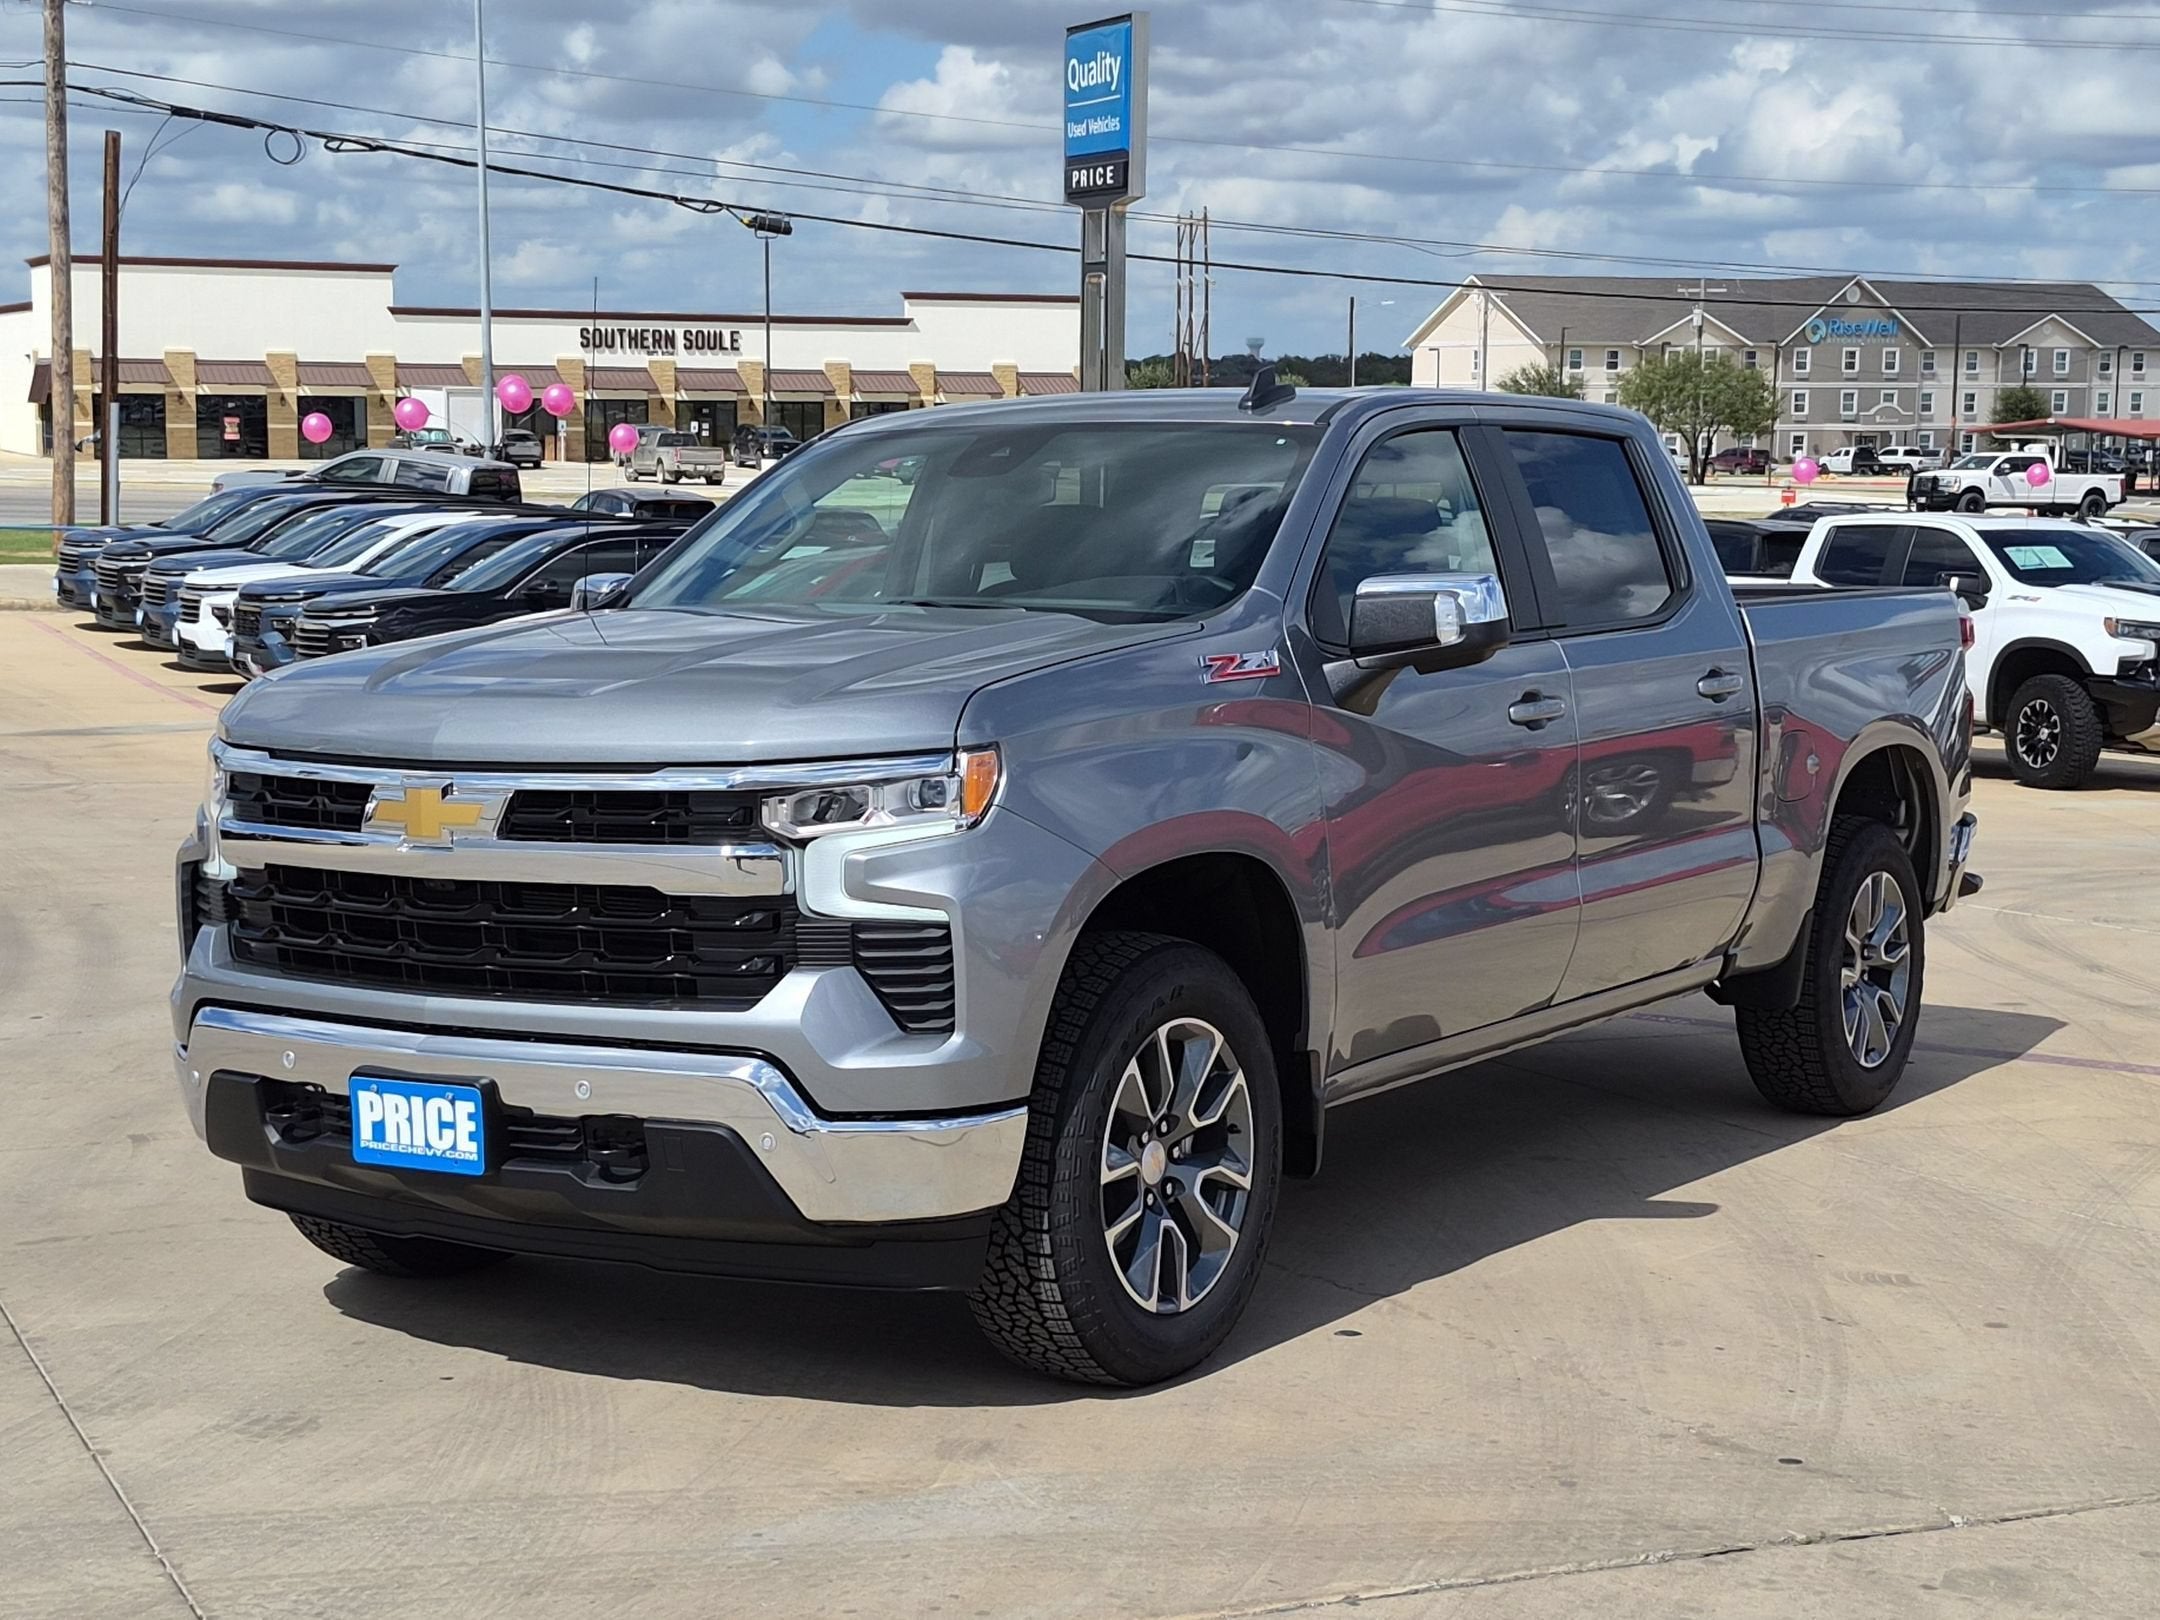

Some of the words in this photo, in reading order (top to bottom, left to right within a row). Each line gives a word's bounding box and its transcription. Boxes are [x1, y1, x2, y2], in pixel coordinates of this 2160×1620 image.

[1067, 51, 1121, 92] Quality
[1067, 119, 1086, 138] Used
[1088, 116, 1121, 135] Vehicles
[1072, 165, 1115, 189] PRICE
[579, 327, 676, 350] SOUTHERN
[683, 329, 742, 351] SOULE
[1198, 649, 1281, 684] Z71
[357, 1090, 478, 1153] PRICE
[359, 1140, 479, 1162] PRICECHEVY.COM
